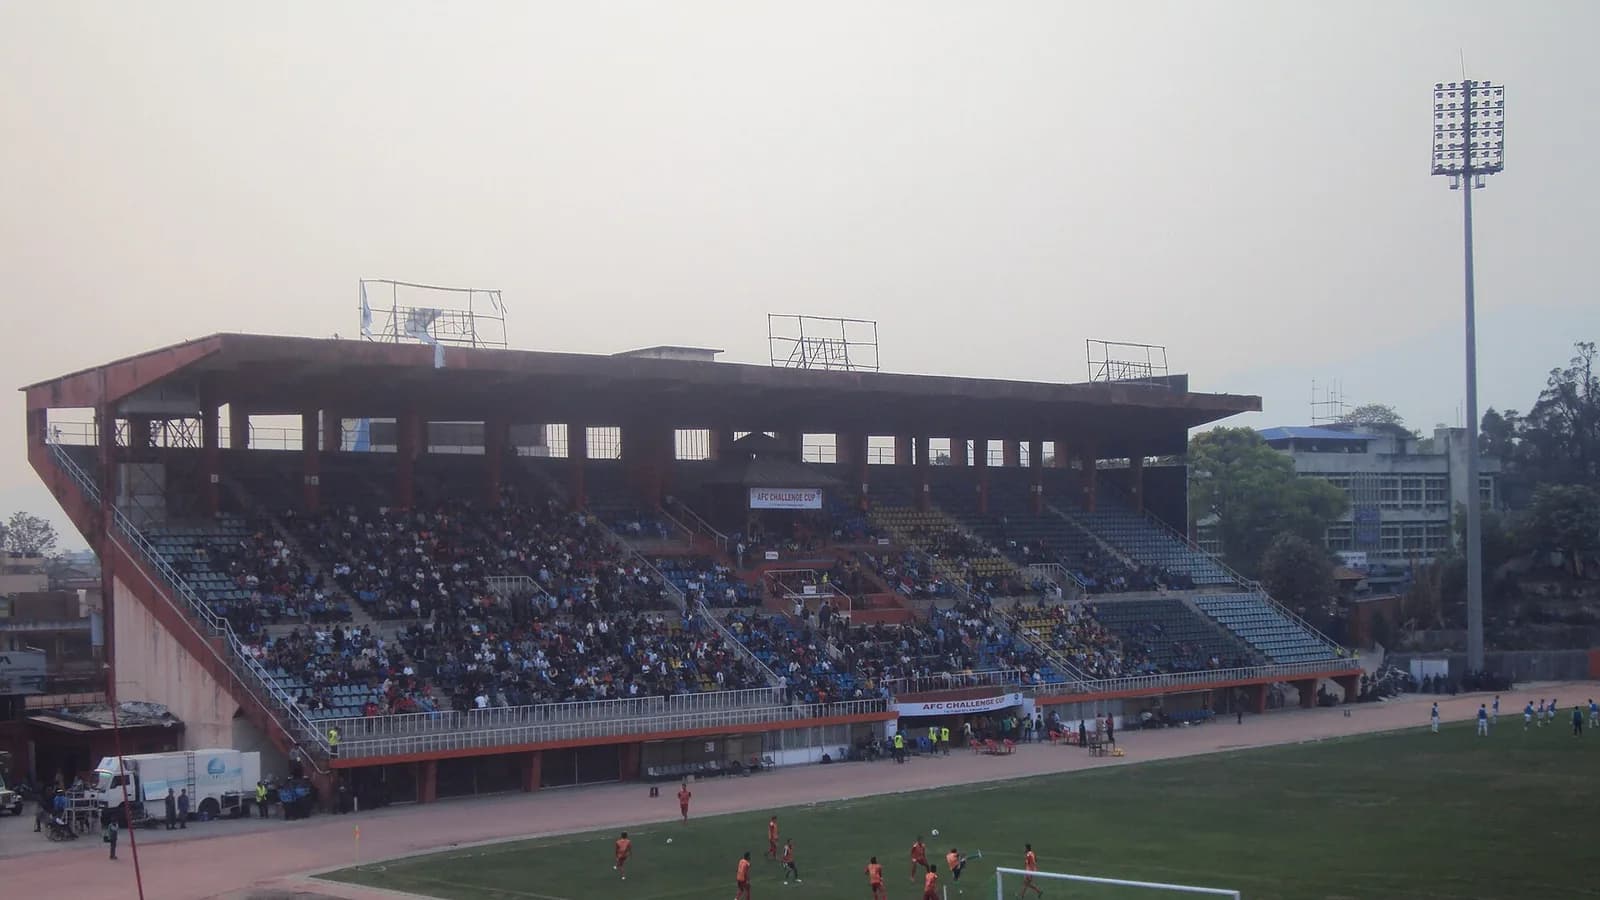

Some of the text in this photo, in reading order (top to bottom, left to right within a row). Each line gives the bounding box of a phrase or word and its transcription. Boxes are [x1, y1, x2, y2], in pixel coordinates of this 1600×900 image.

[757, 492, 816, 503] AFC CHALLENGE CUP
[946, 699, 994, 709] CHALLENGE
